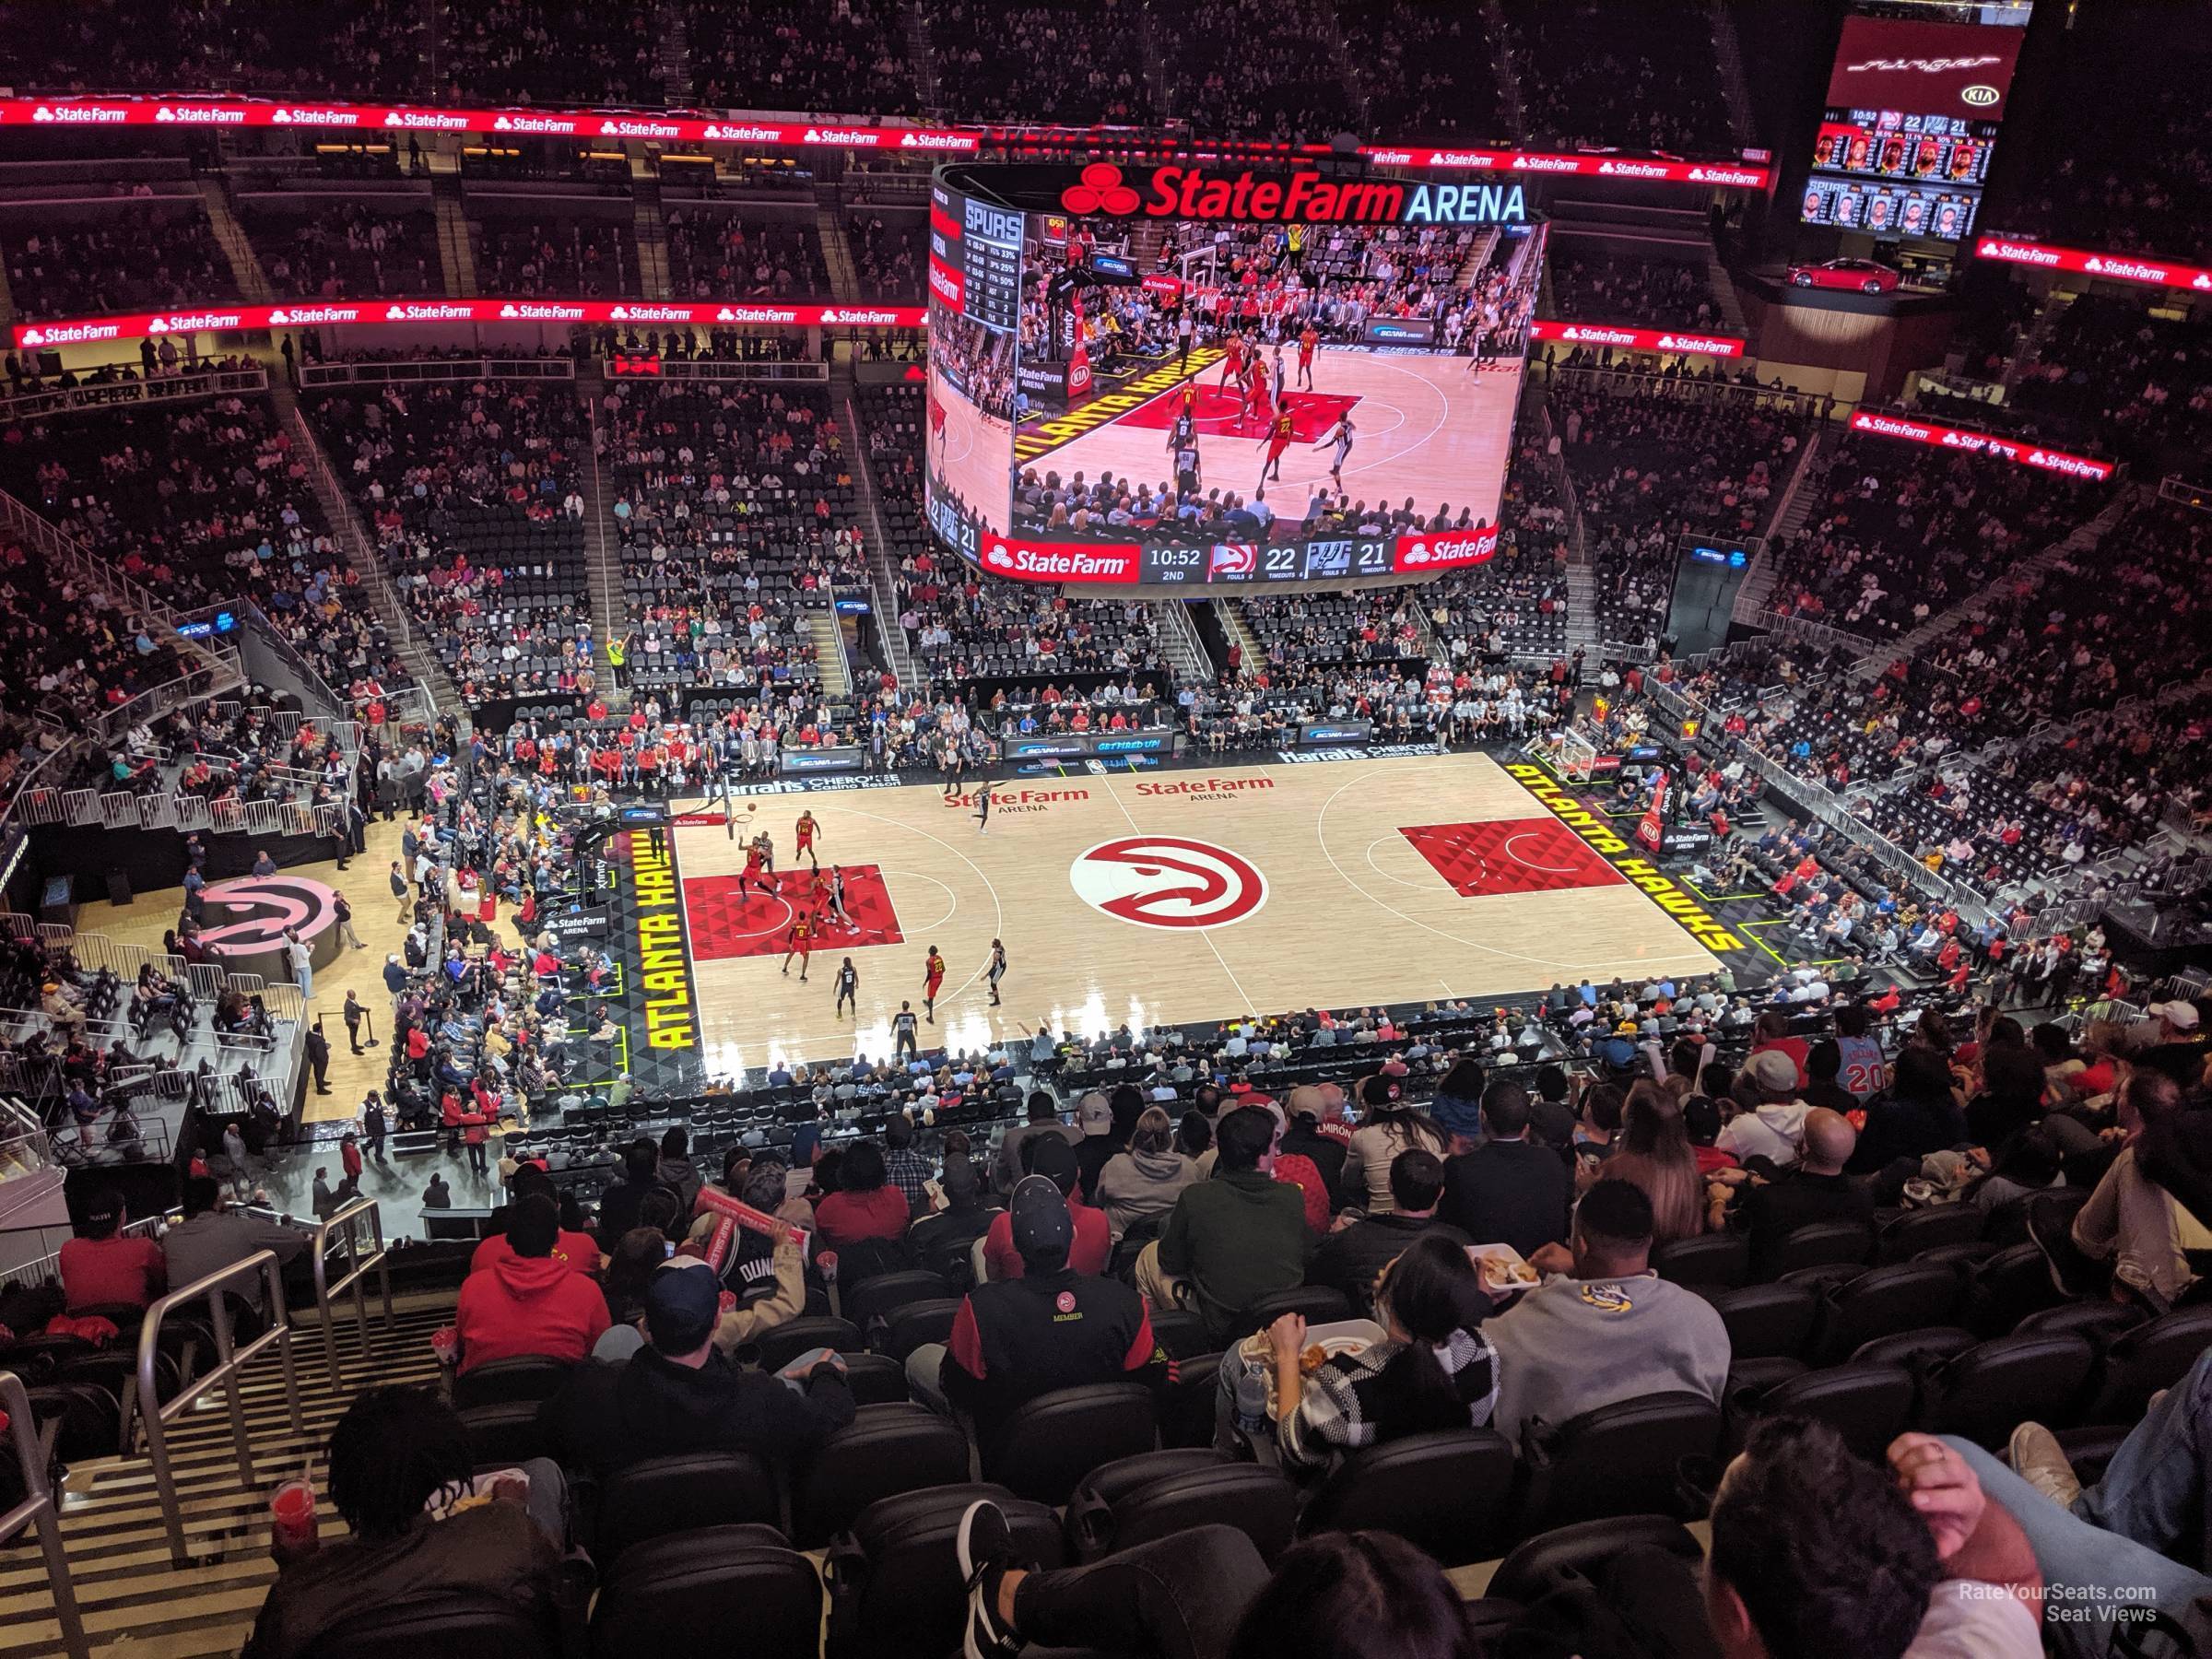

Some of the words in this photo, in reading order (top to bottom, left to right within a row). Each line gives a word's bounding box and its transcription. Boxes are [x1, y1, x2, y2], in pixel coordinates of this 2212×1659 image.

[1853, 111, 1877, 121] 10:52
[1904, 116, 1922, 128] 22
[1950, 120, 1966, 133] 21
[1405, 184, 1526, 222] ARENA
[965, 204, 1022, 242] SPURS
[1001, 249, 1016, 260] 33%
[1000, 262, 1015, 274] 25%
[1000, 275, 1015, 287] 50%
[988, 286, 997, 296] AST
[1004, 289, 1009, 300] 3
[988, 299, 996, 310] STL
[1003, 303, 1009, 312] 2
[1003, 316, 1008, 326] 3
[1064, 311, 1077, 348] xfinity
[1021, 380, 1045, 391] ARENA
[1179, 425, 1187, 436] 8
[1015, 550, 1124, 575] StateFarm
[1150, 550, 1200, 565] 10:52
[1265, 548, 1295, 571] 22
[1359, 543, 1384, 565] 21
[1162, 571, 1184, 581] 2ND
[1361, 566, 1386, 574] TIMEOUTS
[1117, 740, 1143, 749] FIRED
[1277, 748, 1369, 764] Harrah's
[1190, 792, 1238, 802] ARENA
[1661, 786, 1674, 814] xfinity
[998, 804, 1049, 815] ARENA
[1505, 763, 1630, 855] ATLANTA
[1614, 857, 1748, 952] HAWKS
[595, 858, 608, 889] xfinity
[562, 926, 589, 935] ARENA
[935, 962, 943, 973] 22
[639, 913, 695, 1050] ATLANTA
[1846, 1064, 1886, 1093] 20
[1316, 1123, 1352, 1138] LMIRÓN
[1053, 1312, 1084, 1323] MEMBER
